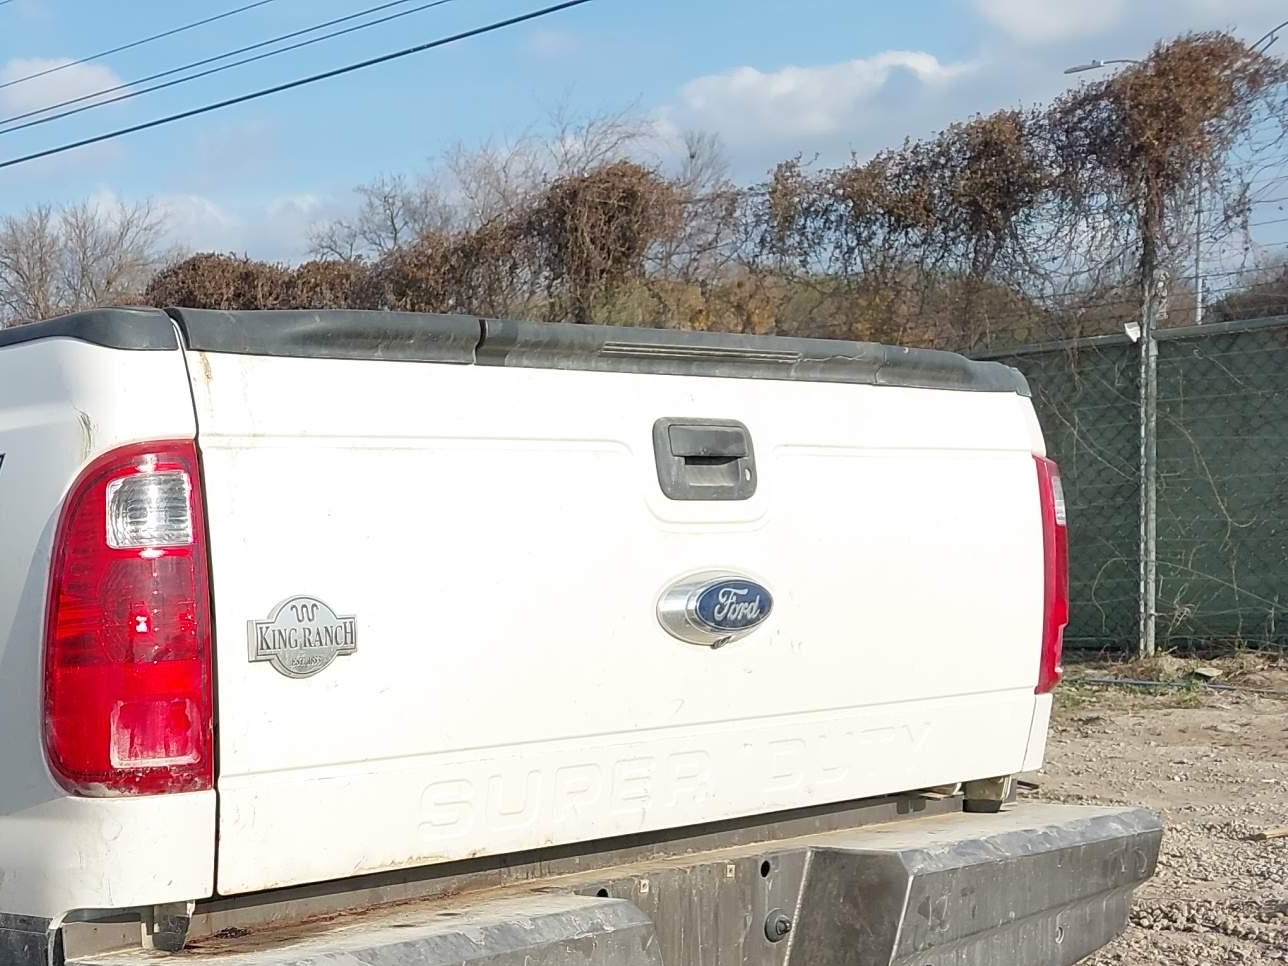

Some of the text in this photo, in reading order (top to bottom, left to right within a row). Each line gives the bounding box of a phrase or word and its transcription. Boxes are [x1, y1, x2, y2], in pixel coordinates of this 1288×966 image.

[714, 588, 760, 620] Ford
[259, 621, 354, 650] KING RANCH
[417, 748, 713, 841] SUPER
